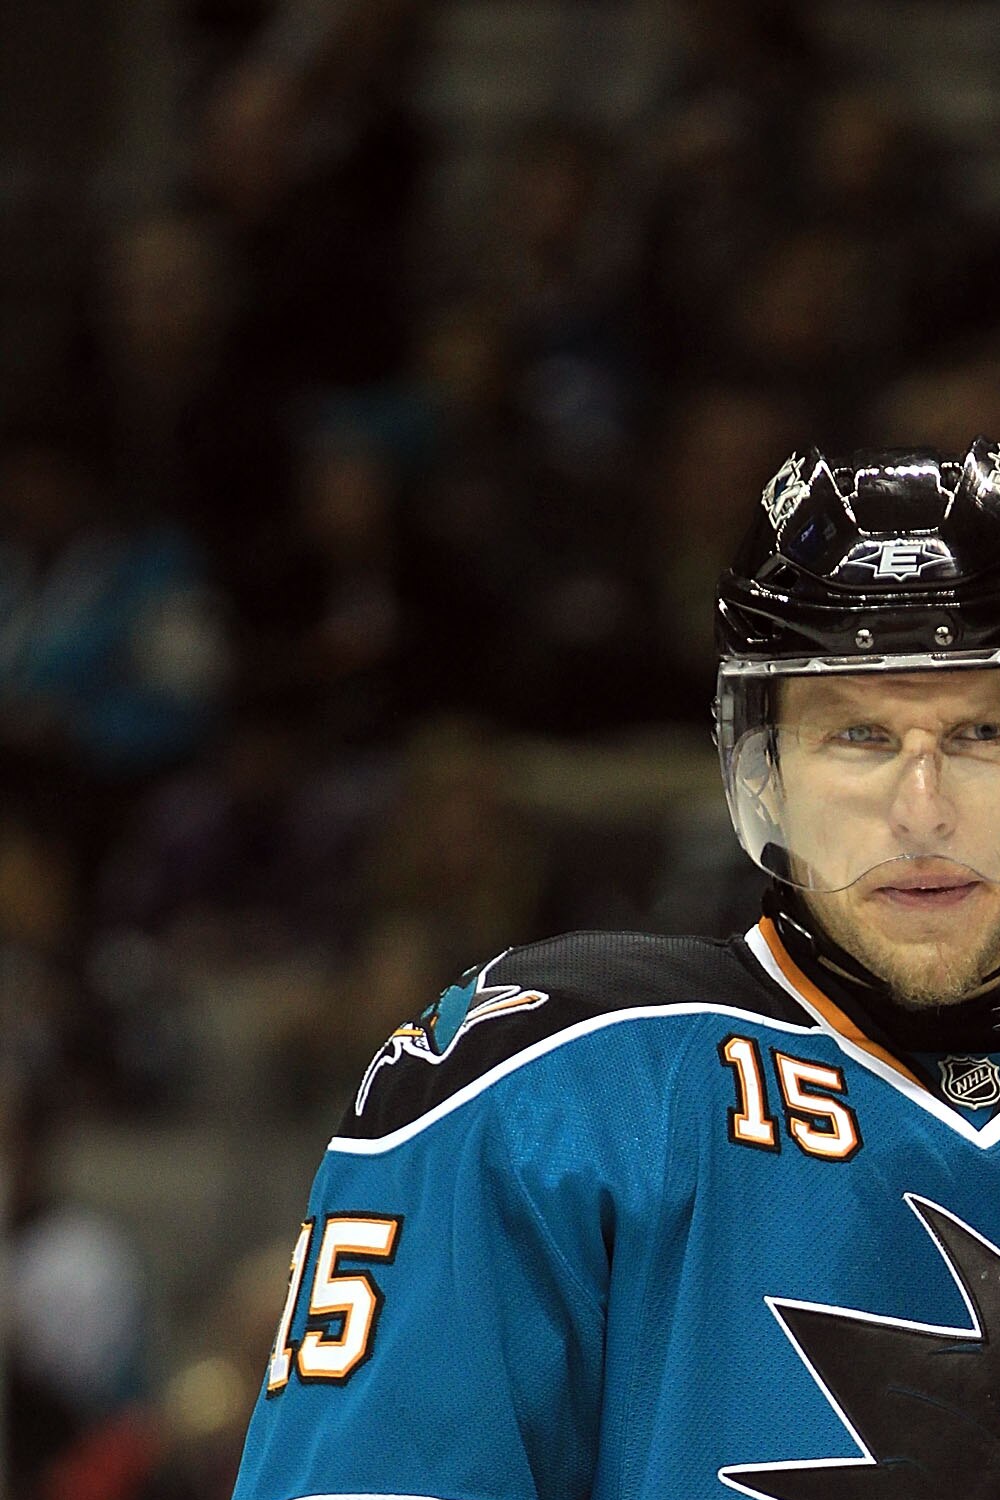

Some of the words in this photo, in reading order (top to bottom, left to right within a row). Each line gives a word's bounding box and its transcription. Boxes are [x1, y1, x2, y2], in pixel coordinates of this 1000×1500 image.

[718, 1033, 864, 1162] 15
[955, 1068, 990, 1095] NHL
[266, 1212, 404, 1397] 15
